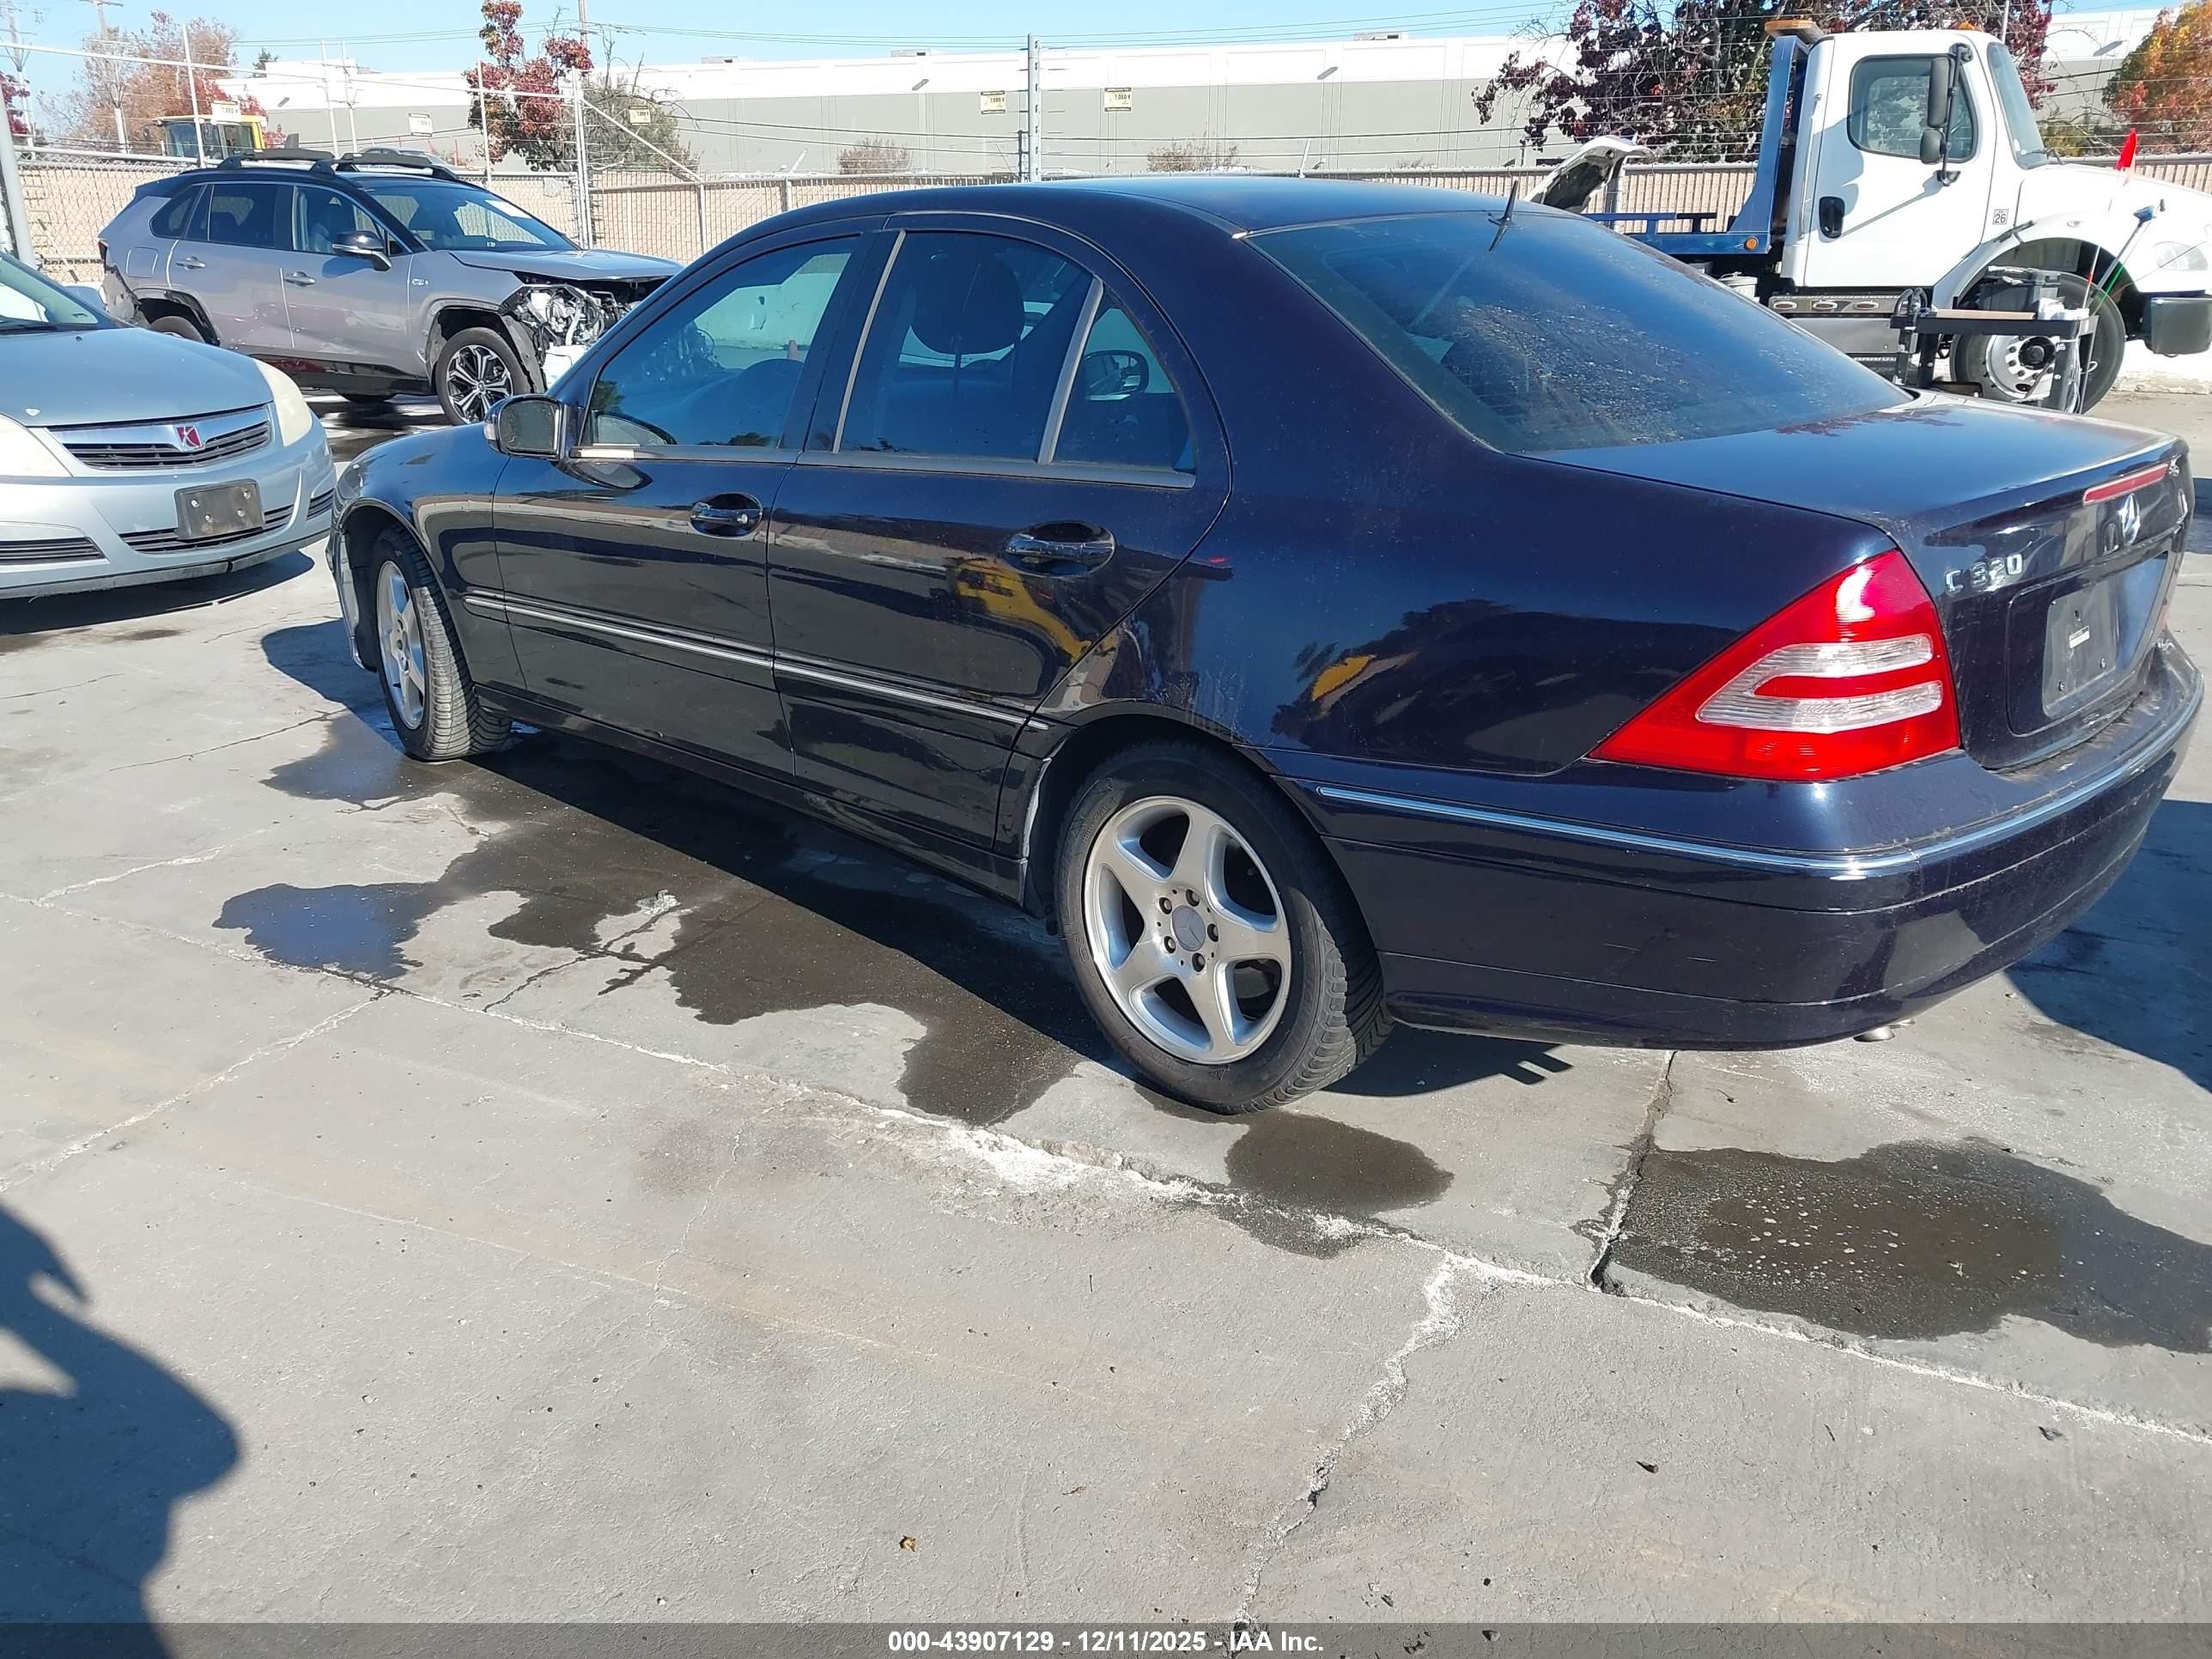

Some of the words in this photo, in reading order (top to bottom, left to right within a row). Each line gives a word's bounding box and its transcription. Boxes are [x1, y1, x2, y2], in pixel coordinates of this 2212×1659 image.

[1995, 213, 2006, 223] 26
[1944, 568, 1965, 593] C
[1971, 554, 2022, 589] 320
